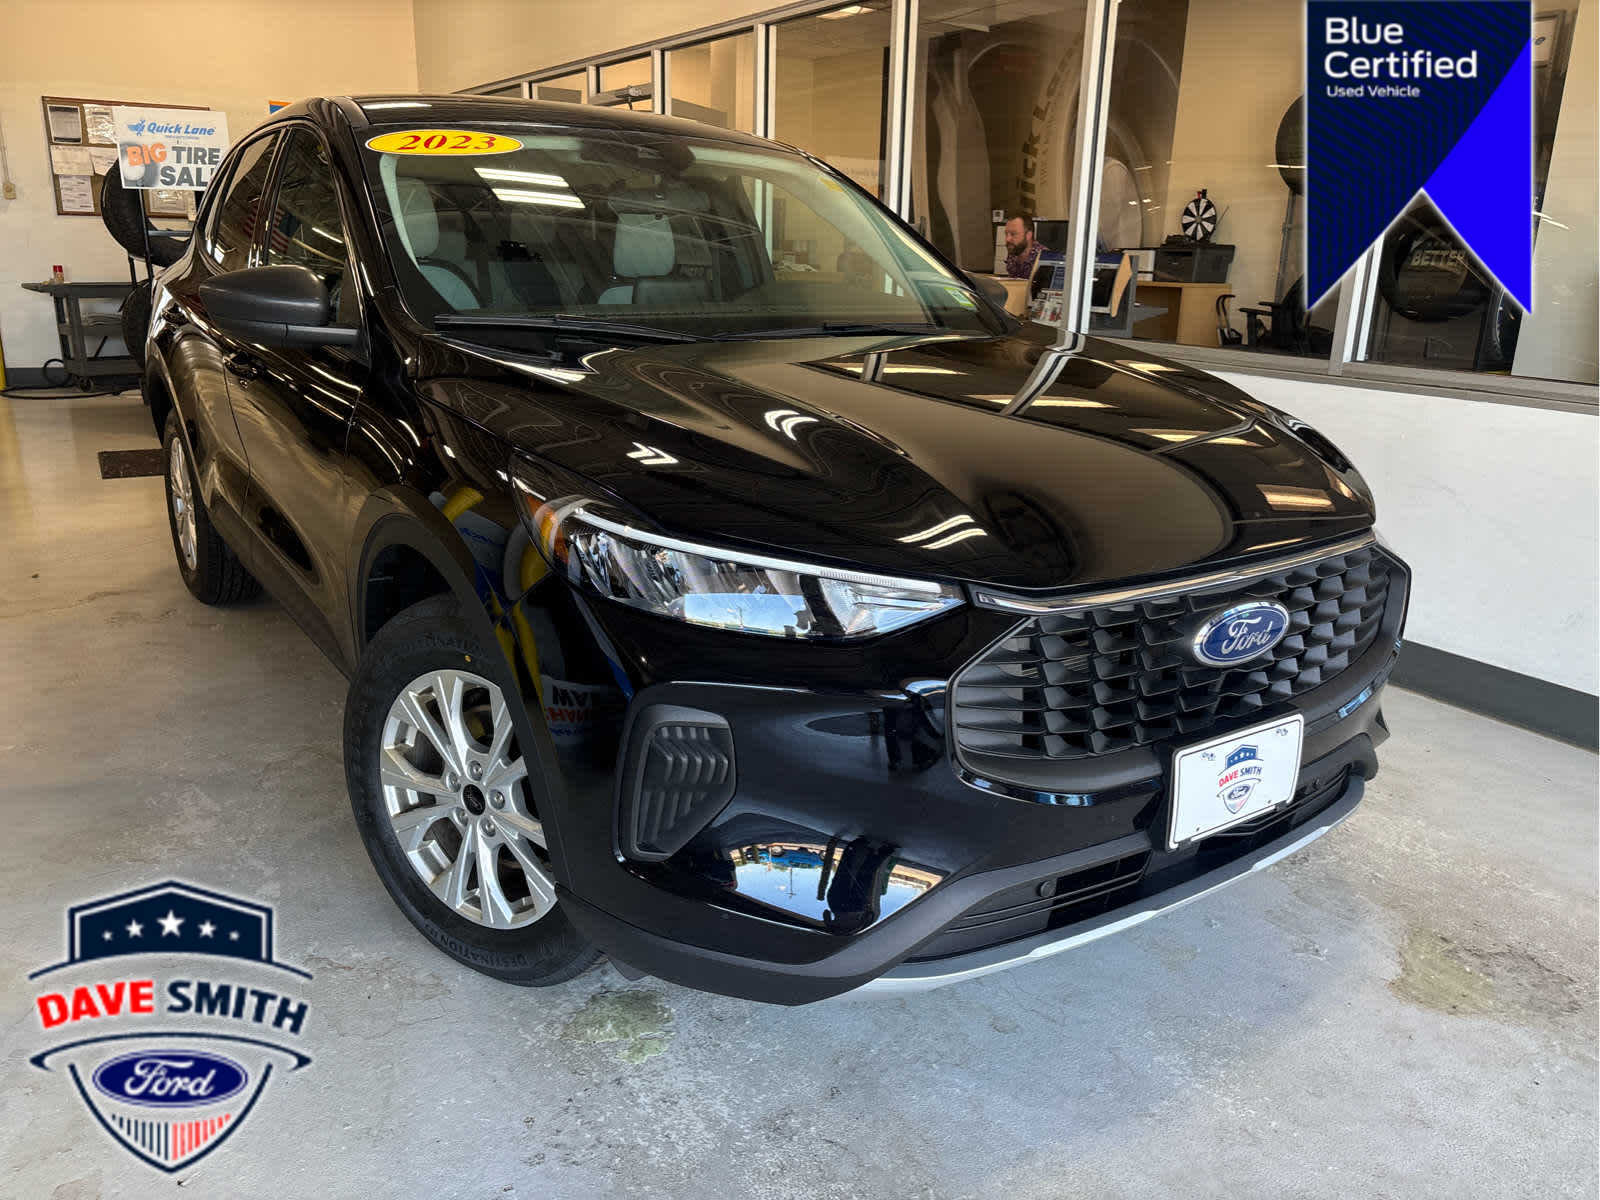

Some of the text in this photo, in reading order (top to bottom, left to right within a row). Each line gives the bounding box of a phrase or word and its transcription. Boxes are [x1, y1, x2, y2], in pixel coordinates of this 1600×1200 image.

[147, 122, 216, 136] Quick Lane
[126, 141, 167, 166] BIG
[171, 146, 221, 165] TIRE
[396, 135, 497, 150] 2023
[160, 165, 215, 187] SAL
[1222, 617, 1273, 655] Ford
[1218, 765, 1263, 788] DAVE SMITH
